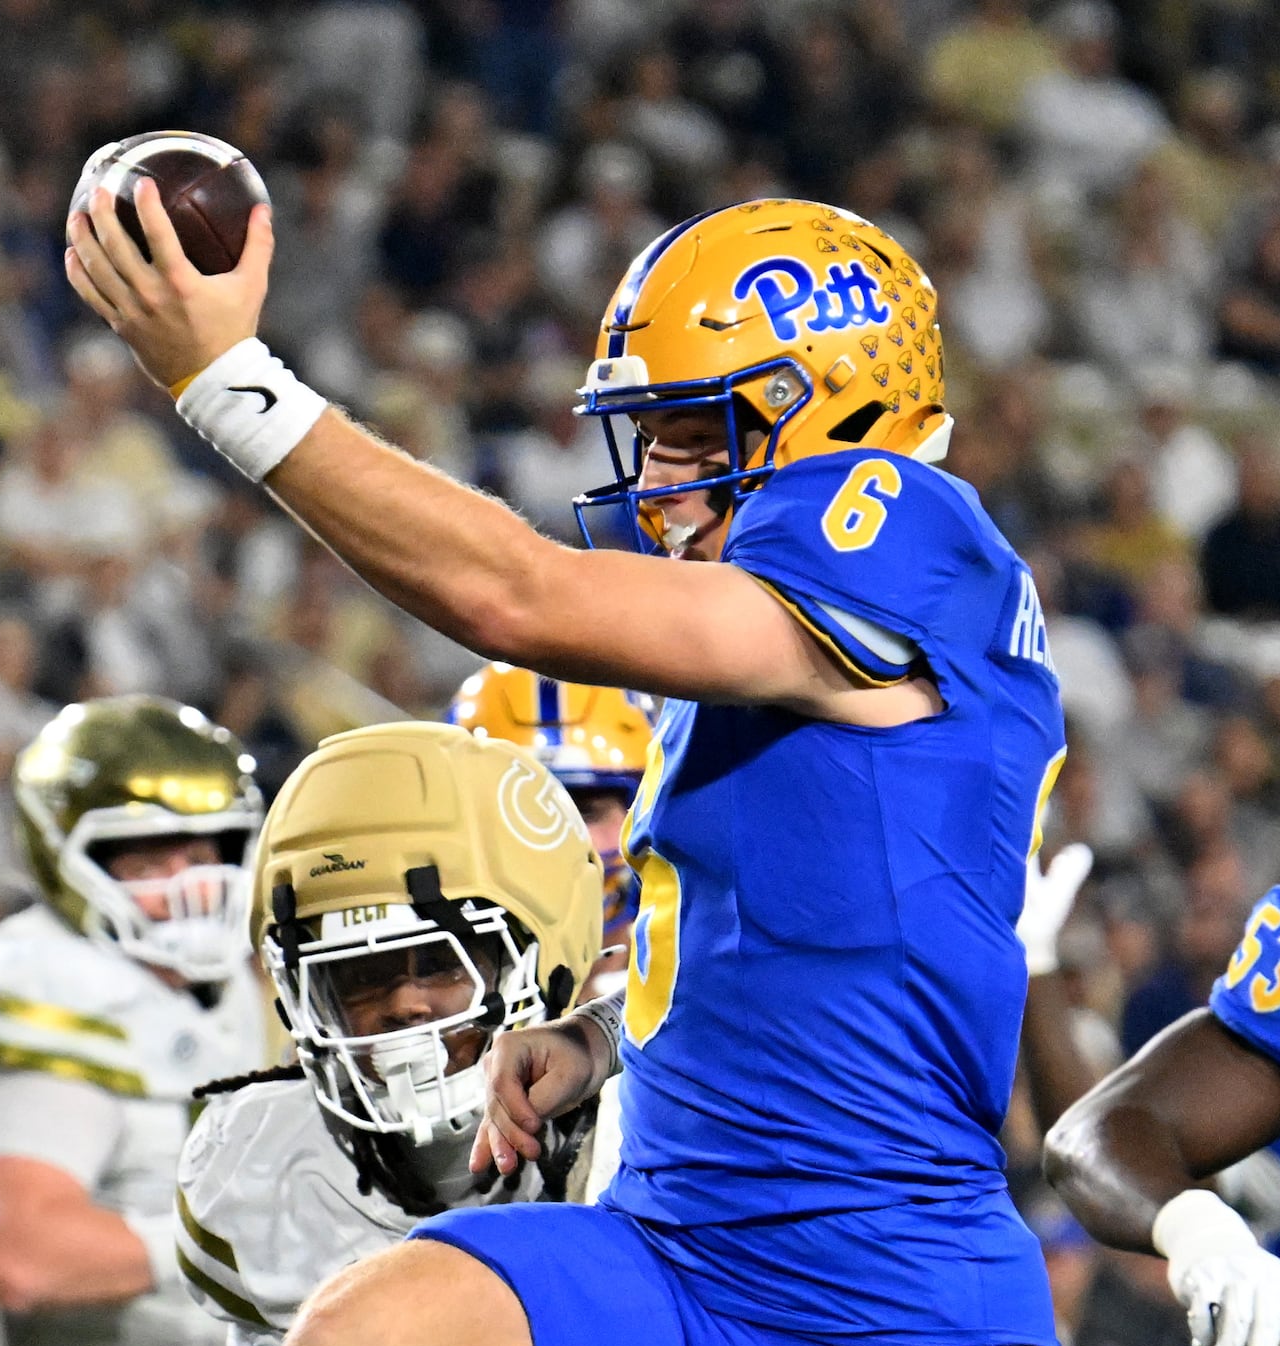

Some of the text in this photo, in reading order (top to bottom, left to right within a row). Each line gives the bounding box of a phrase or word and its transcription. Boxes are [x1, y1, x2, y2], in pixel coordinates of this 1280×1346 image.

[733, 256, 889, 342] Pitt
[821, 458, 903, 552] 6
[341, 902, 387, 927] TECH
